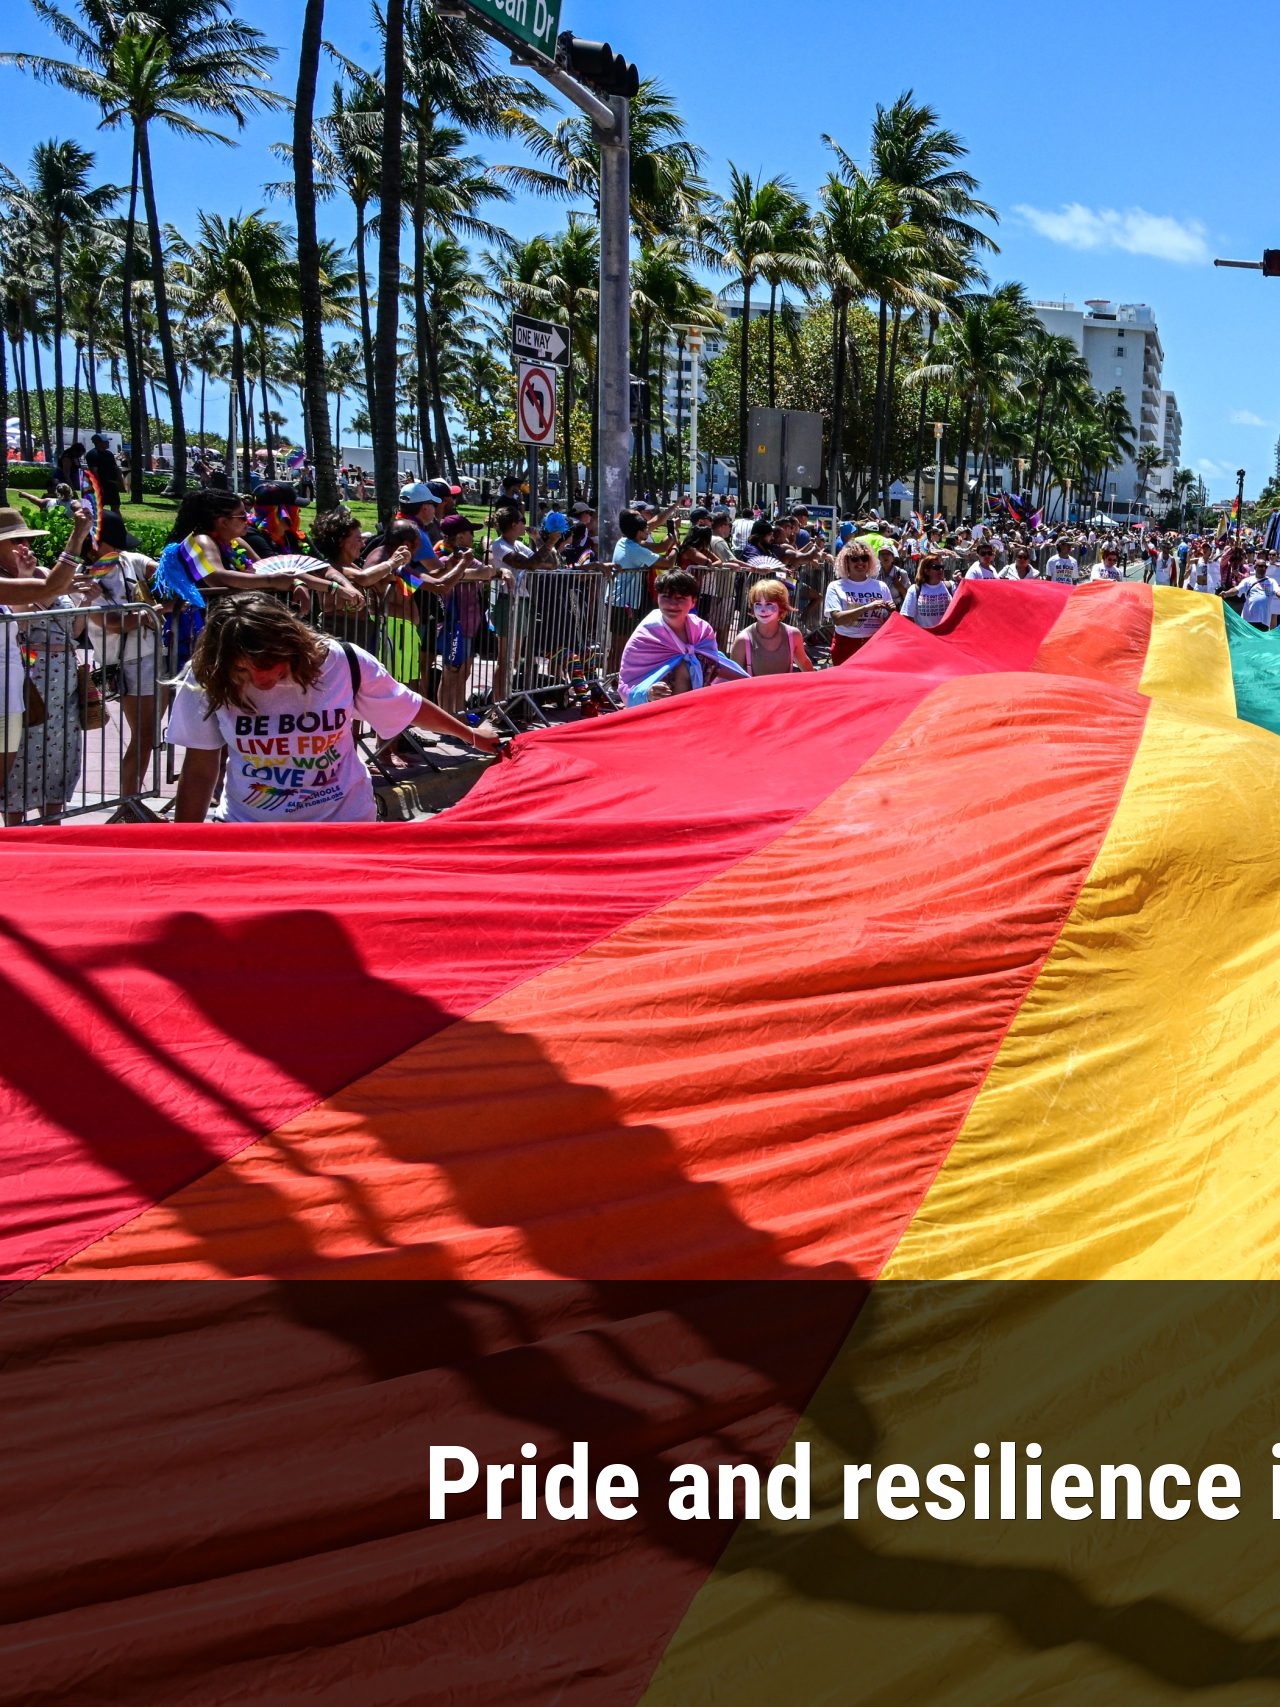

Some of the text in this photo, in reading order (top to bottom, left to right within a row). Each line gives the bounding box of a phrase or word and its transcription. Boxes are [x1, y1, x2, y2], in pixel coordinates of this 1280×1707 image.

[533, 0, 554, 43] Dr
[517, 327, 551, 350] ONE WAY
[235, 708, 347, 736] BE BOLD
[236, 737, 290, 756] LIVE
[292, 744, 341, 770] WOKE
